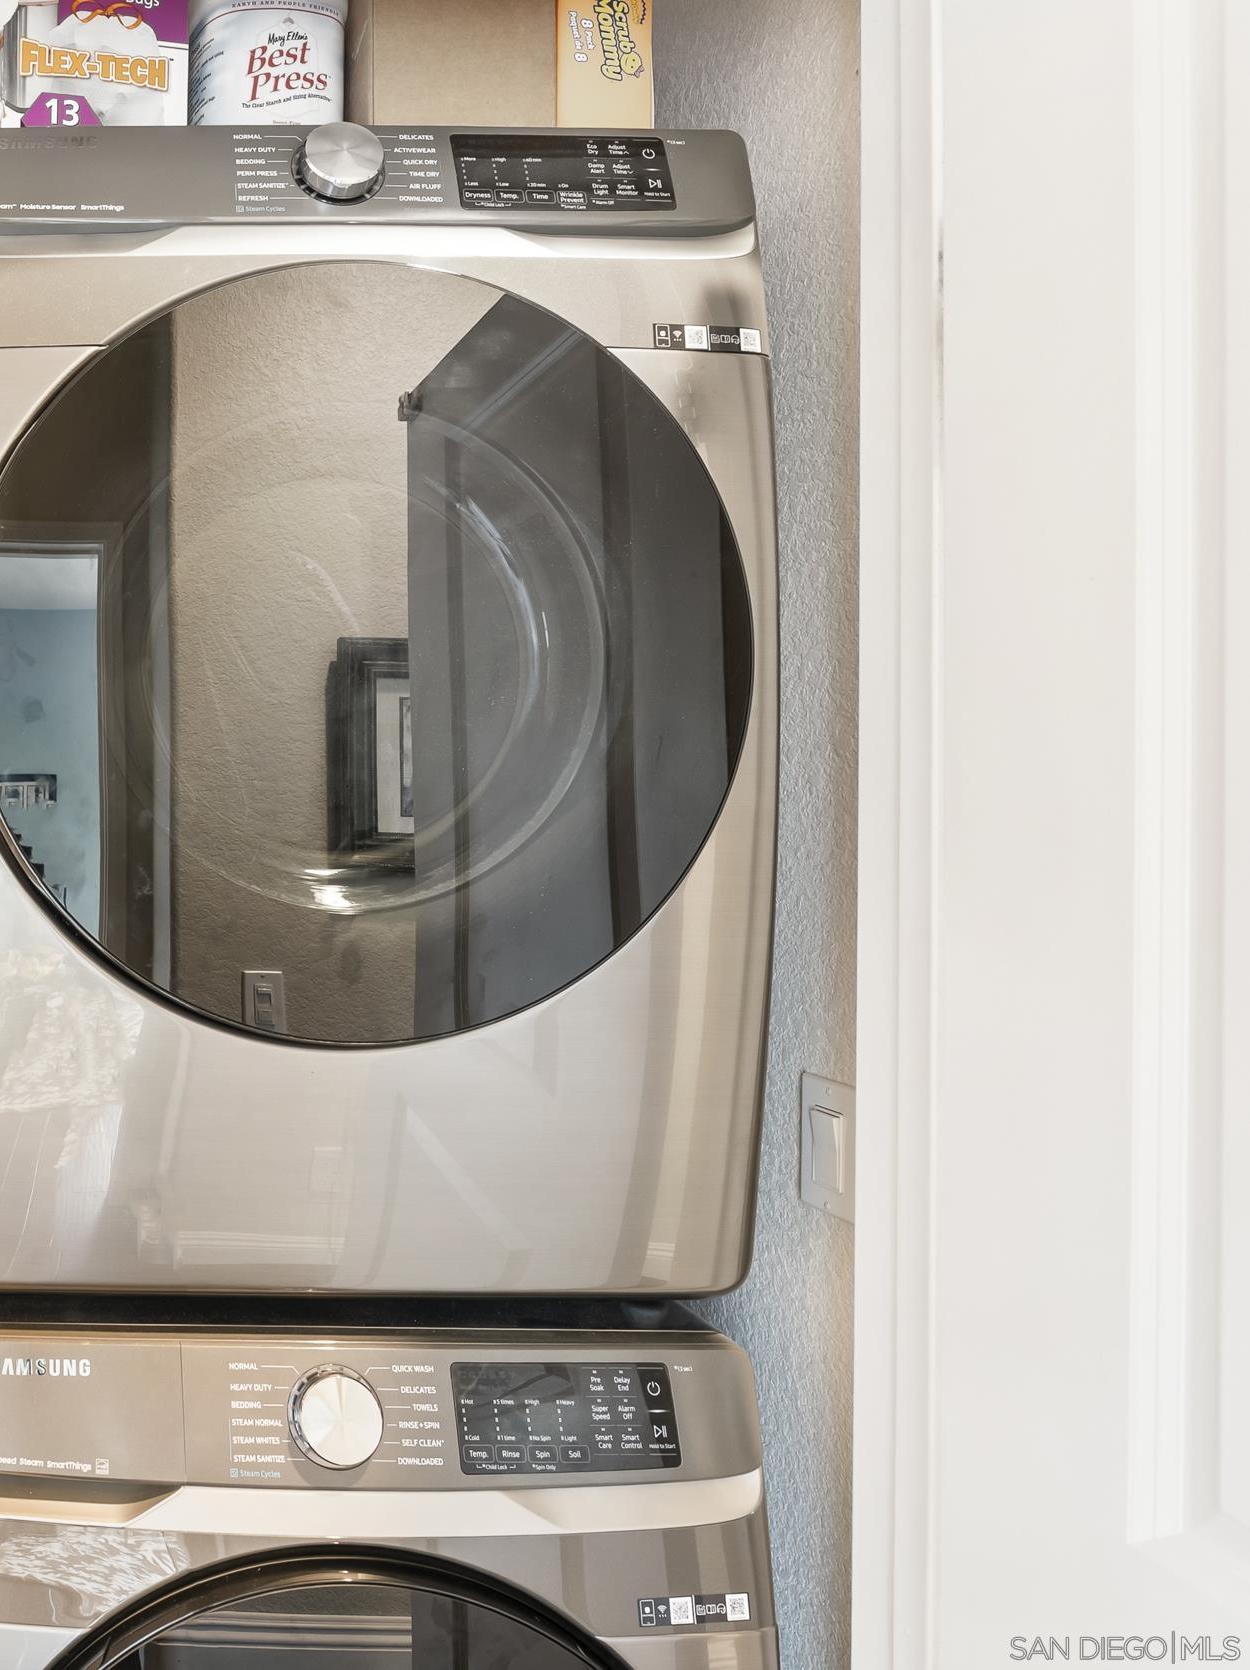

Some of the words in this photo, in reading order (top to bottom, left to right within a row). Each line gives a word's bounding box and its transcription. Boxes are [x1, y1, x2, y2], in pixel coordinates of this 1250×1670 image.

[581, 19, 594, 29] 8
[612, 0, 636, 54] Scrub
[268, 33, 286, 47] Mary
[286, 31, 308, 41] Ellen's
[585, 30, 596, 50] Pack
[593, 0, 623, 81] Mommy
[246, 41, 310, 76] Best
[574, 52, 588, 62] 8
[20, 37, 169, 91] FLEX-TECH
[247, 71, 328, 102] Press
[265, 98, 282, 107] Starch
[45, 98, 80, 126] 13
[465, 191, 492, 199] Dryness
[51, 203, 77, 211] Sensor
[265, 205, 286, 213] Cycles
[413, 1365, 434, 1373] WASH
[613, 1376, 631, 1384] Delay
[229, 1383, 254, 1391] HEAVY
[253, 1383, 272, 1391] DUTY
[400, 1386, 436, 1394] DELICATES
[589, 1384, 604, 1392] Soak
[617, 1384, 630, 1392] End
[411, 1404, 438, 1412] TOWELS
[592, 1413, 610, 1421] Speed
[231, 1418, 254, 1426] STEAM
[254, 1419, 284, 1427] NORMAL
[398, 1421, 419, 1429] RINSE
[424, 1421, 440, 1429] SPIN
[232, 1436, 256, 1444] STEAM
[256, 1436, 280, 1444] WHITES
[501, 1450, 520, 1458] Rinse
[535, 1450, 550, 1459] Spin
[568, 1450, 582, 1458] Soil
[233, 1454, 256, 1463] STEAM
[256, 1455, 286, 1463] SANITIZE
[397, 1457, 444, 1466] DOWNLOADED
[19, 1457, 44, 1468] Steam
[46, 1460, 92, 1472] SmartThings
[240, 1470, 261, 1478] Steam
[261, 1470, 281, 1478] Cycles
